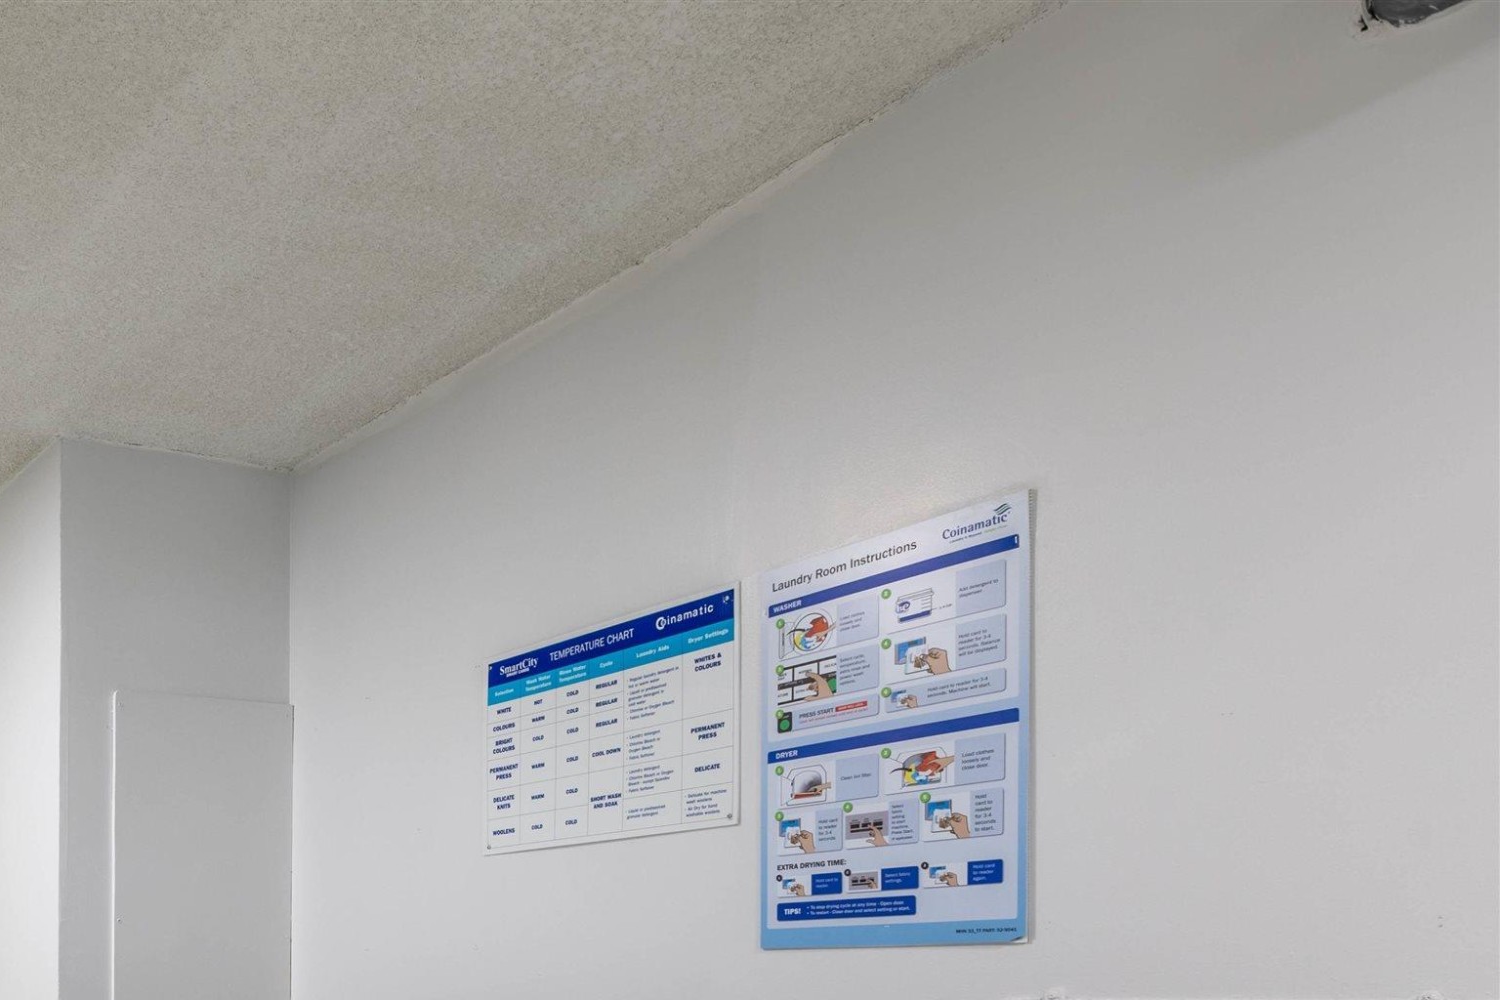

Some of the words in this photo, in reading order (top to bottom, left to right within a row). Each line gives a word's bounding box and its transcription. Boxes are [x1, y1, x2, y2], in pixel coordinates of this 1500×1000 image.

[942, 513, 1008, 540] Coinamatic
[772, 572, 813, 593] Laundry
[815, 562, 847, 580] Room
[850, 541, 918, 569] Instructions
[772, 600, 802, 613] WASHER
[705, 628, 729, 640] Settings
[550, 636, 605, 662] TEMPERATURE
[606, 627, 635, 645] CHART
[694, 653, 716, 664] WHITES
[499, 657, 538, 676] SmartCity
[694, 661, 722, 672] COLOURS
[595, 680, 618, 689] REGULAR
[595, 698, 618, 707] REGULAR
[496, 706, 512, 715] WHITE
[566, 707, 579, 715] COLD
[817, 707, 834, 715] START
[493, 722, 516, 732] COLOURS
[595, 718, 618, 728] REGULAR
[690, 722, 725, 734] PERMANENT
[698, 732, 717, 740] PRESS
[495, 738, 513, 746] BRIGHT
[493, 745, 516, 755] COLOURS
[605, 747, 621, 755] DOWN
[775, 750, 798, 759] DRYER
[489, 763, 519, 774] PERMANENT
[694, 763, 720, 773] DELICATE
[495, 773, 512, 781] PRESS
[493, 794, 515, 803] DELICATE
[492, 827, 515, 836] WOOLENS
[777, 863, 799, 871] EXTRA
[799, 861, 826, 869] DRYING
[827, 859, 847, 867] TIME:
[783, 908, 802, 916] TIPS!
